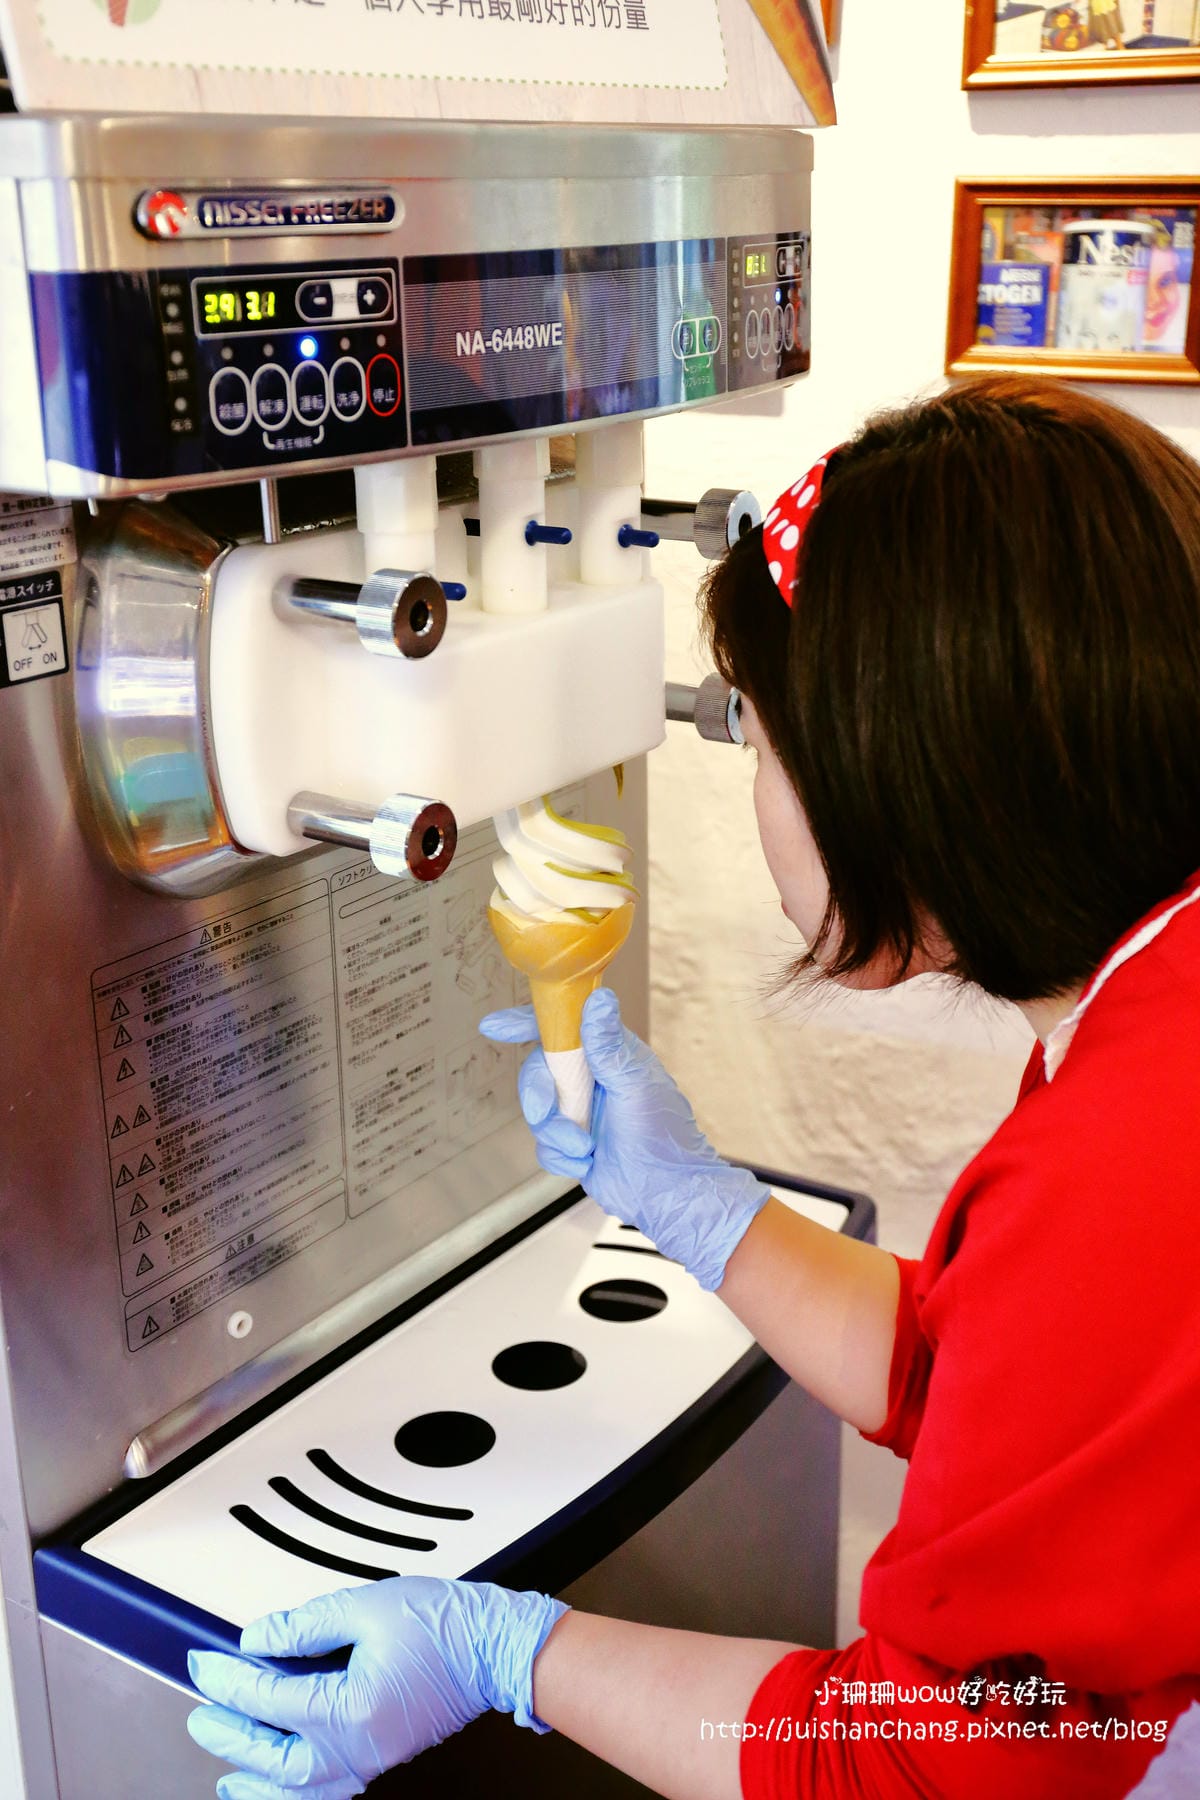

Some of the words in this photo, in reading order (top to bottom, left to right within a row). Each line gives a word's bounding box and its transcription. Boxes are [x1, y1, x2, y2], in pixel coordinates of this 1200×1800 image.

[203, 199, 285, 227] NISSEI
[291, 198, 387, 224] FREEZER
[456, 322, 563, 357] NA-6448WE
[373, 388, 396, 403] 停止
[13, 657, 33, 672] OFF
[42, 651, 57, 665] ON
[339, 865, 376, 886] ソフトクリ
